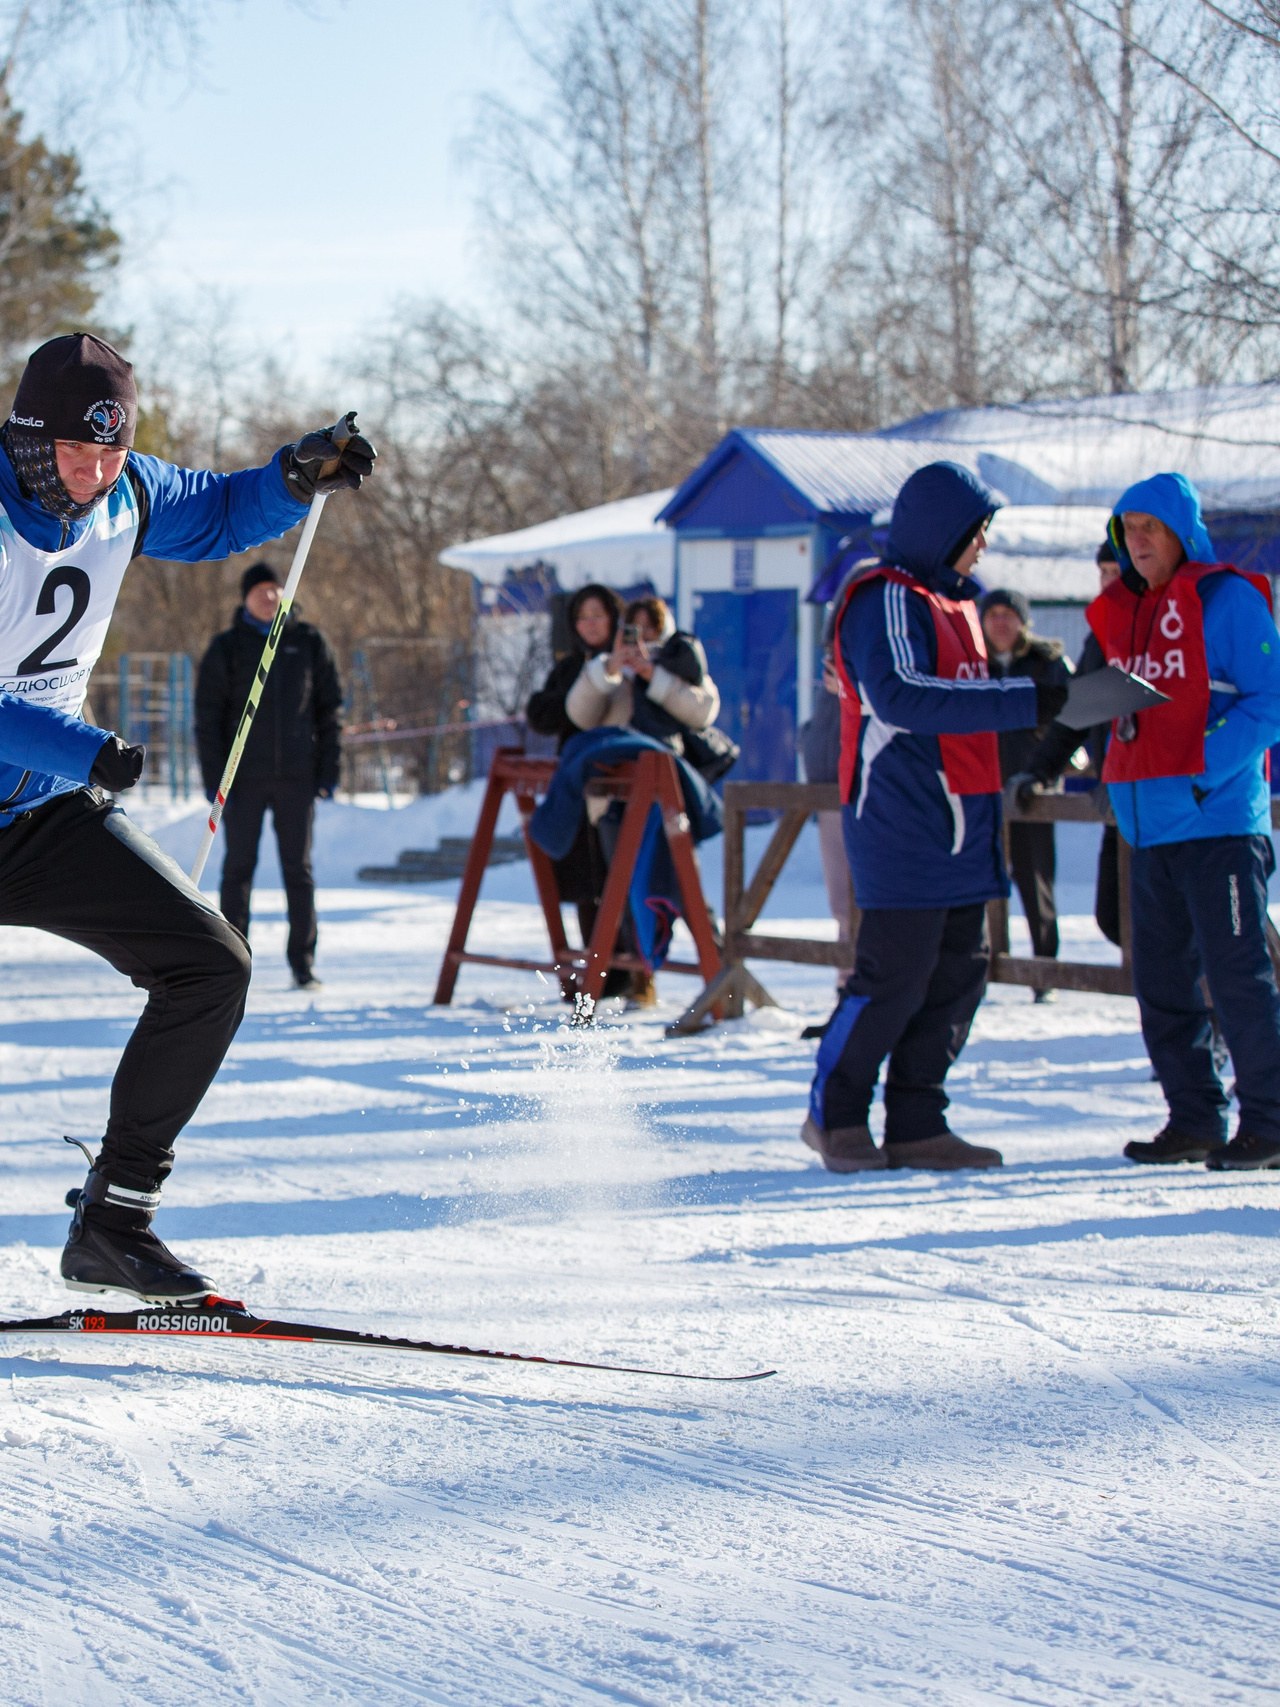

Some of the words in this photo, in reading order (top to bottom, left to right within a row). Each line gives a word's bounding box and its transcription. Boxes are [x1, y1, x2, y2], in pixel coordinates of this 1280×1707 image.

[16, 415, 45, 428] odlo
[16, 565, 91, 676] 2
[2, 668, 86, 694] СДЮСШОР
[68, 1316, 106, 1330] SK193
[136, 1315, 232, 1333] ROSSIGNOL
